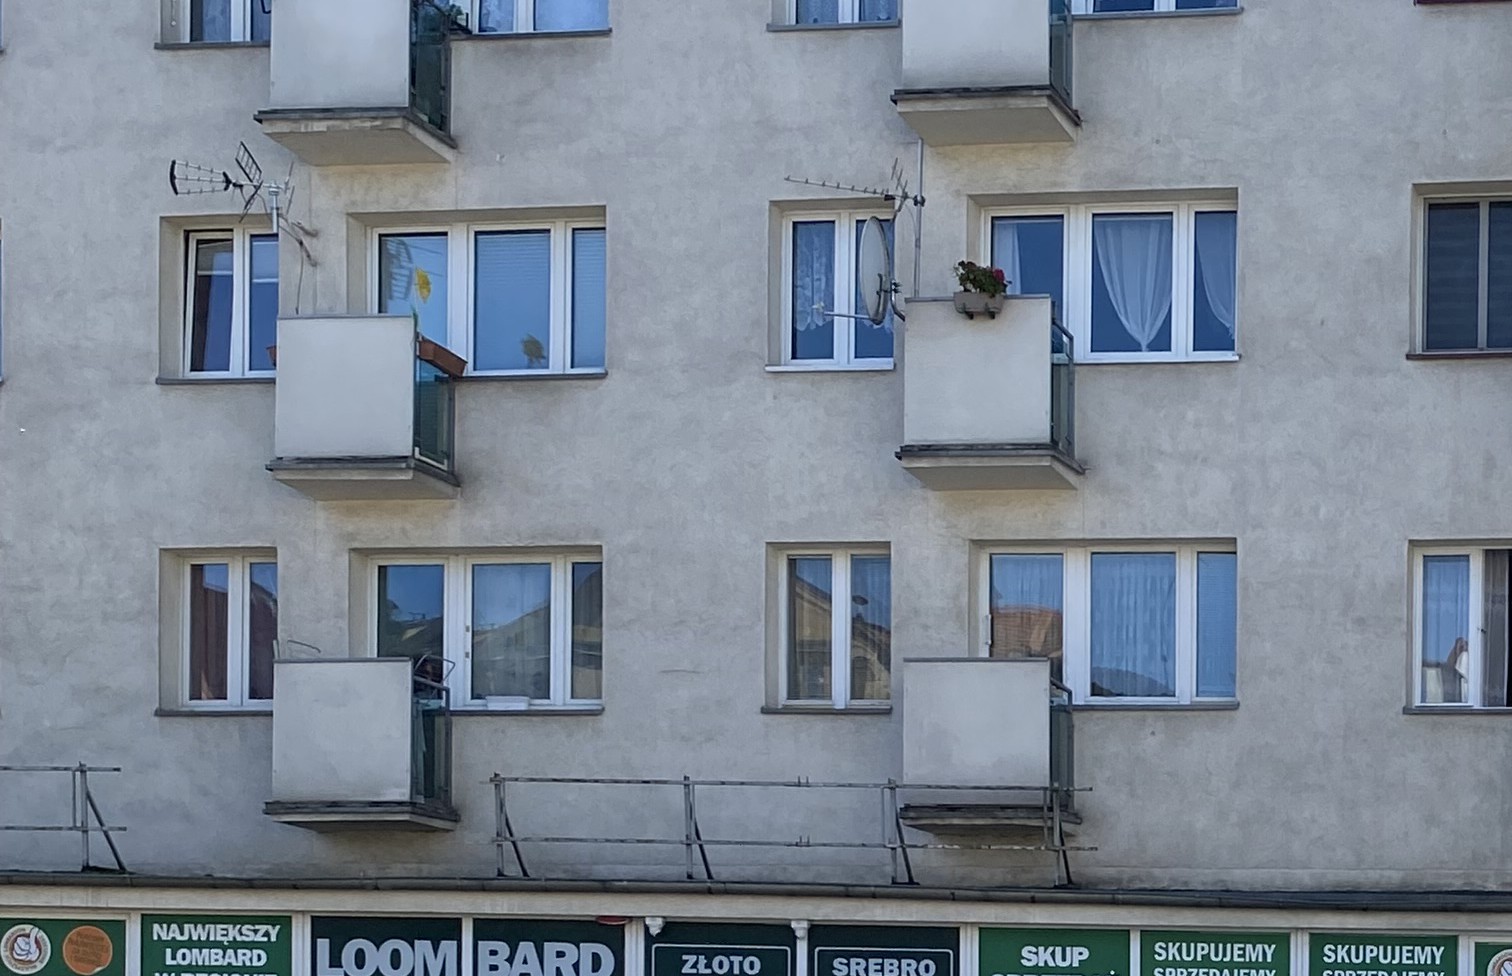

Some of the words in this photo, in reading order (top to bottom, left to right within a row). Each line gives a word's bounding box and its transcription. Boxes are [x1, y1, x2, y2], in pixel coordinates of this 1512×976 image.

[152, 923, 280, 946] NAJWIĘKSZY
[165, 948, 268, 967] LOMBARD
[1020, 945, 1090, 968] SKUP
[1153, 942, 1277, 963] SKUPUJEMY
[1322, 944, 1445, 966] SKUPUJEMY
[681, 954, 762, 975] ZŁOTO
